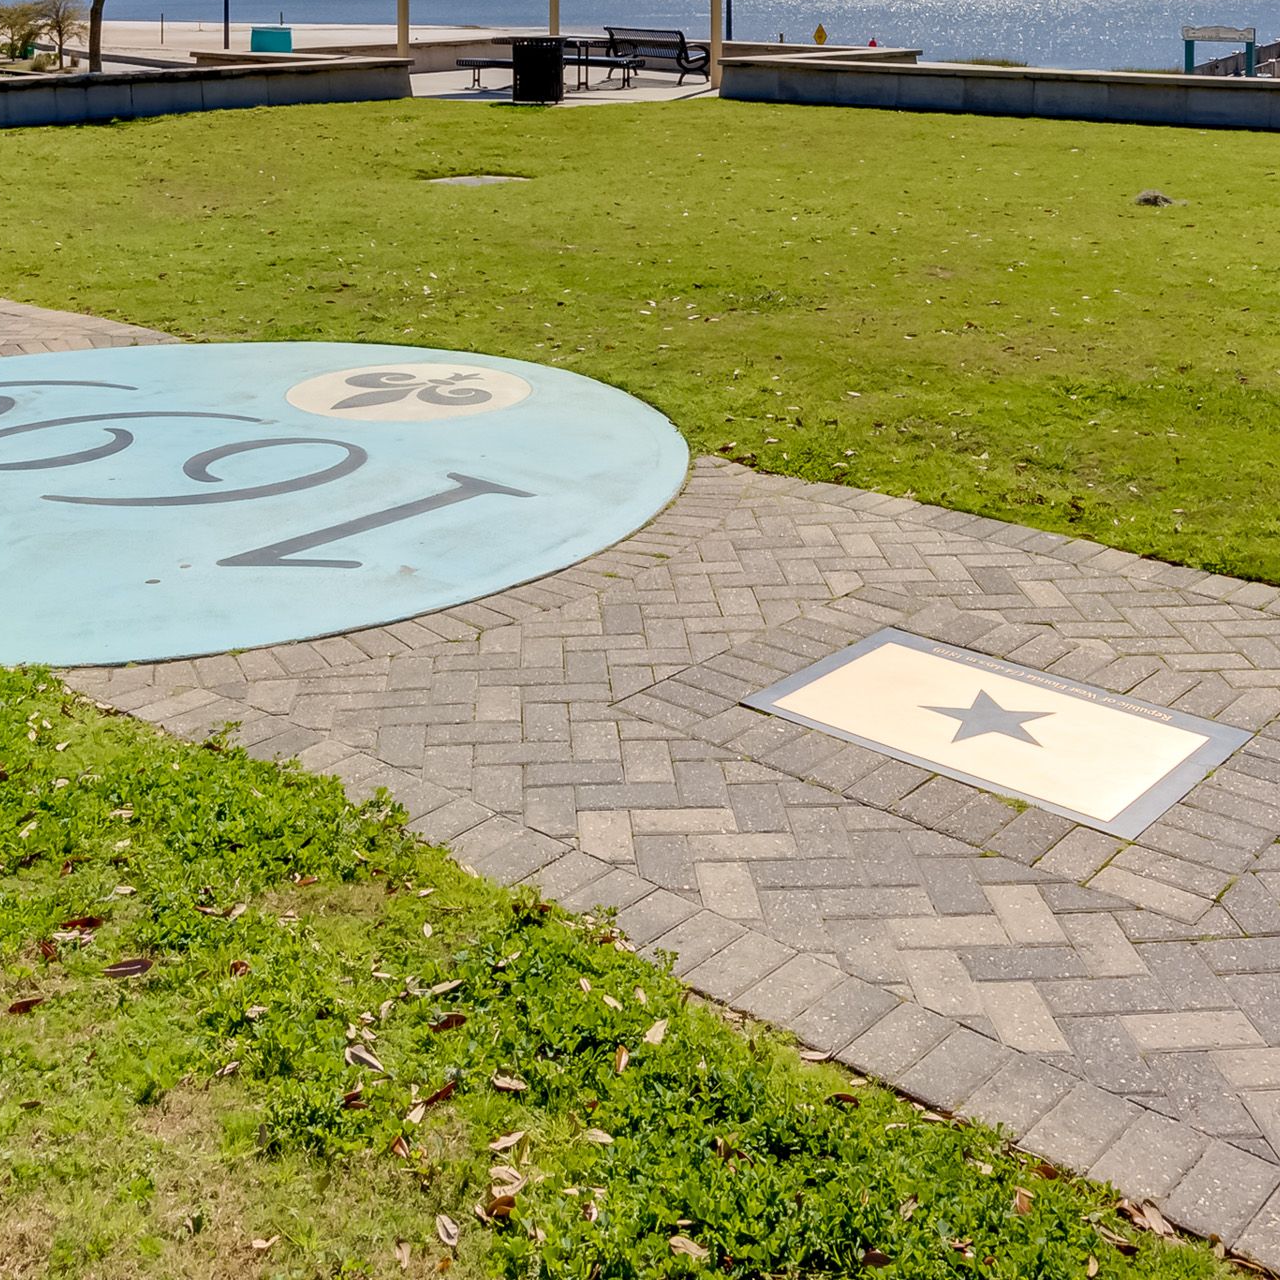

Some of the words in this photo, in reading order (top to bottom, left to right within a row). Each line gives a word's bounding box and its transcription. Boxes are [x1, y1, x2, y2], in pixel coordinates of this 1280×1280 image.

[1026, 673, 1068, 691] Florida
[1069, 686, 1098, 700] West
[1103, 696, 1117, 704] of
[1118, 701, 1173, 722] Republic
